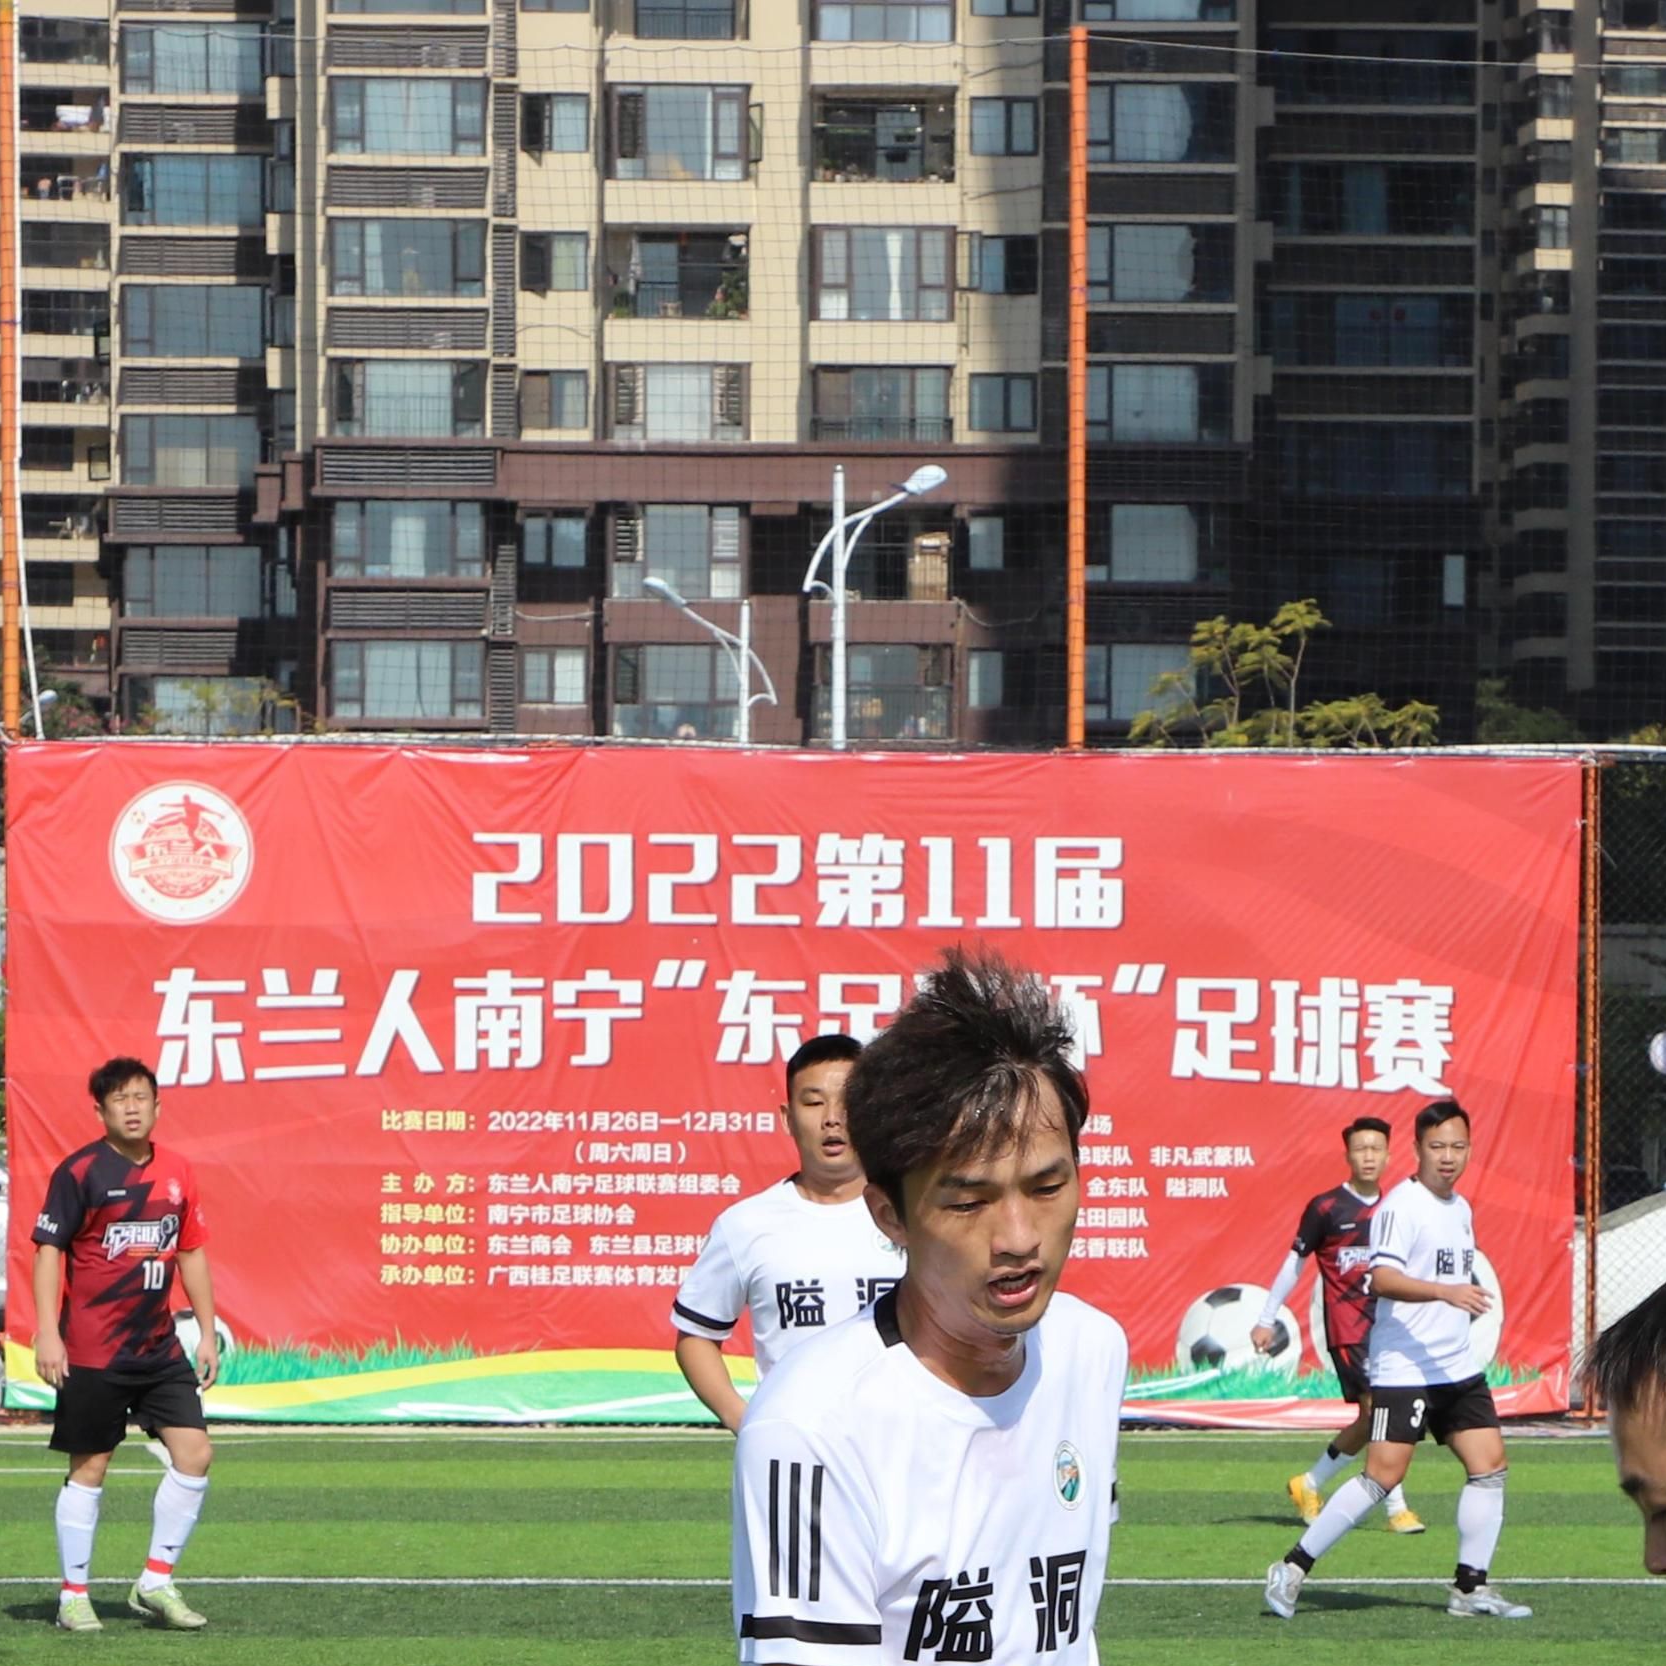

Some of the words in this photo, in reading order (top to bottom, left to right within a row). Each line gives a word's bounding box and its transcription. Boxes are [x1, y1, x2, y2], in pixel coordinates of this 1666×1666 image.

[472, 832, 1123, 928] 2022第11届
[380, 1110, 476, 1132] 比赛日期：
[574, 1141, 687, 1165] （周六周日）
[488, 1173, 741, 1194] 东兰人南宁足球联赛组委会
[1086, 1177, 1149, 1198] 金东队
[1165, 1177, 1229, 1198] 隘洞队
[380, 1203, 476, 1225] 指导单位：
[488, 1204, 636, 1225] 南宁市足球协会
[380, 1234, 476, 1256] 协办单位：
[488, 1235, 572, 1256] 东兰商会
[142, 1260, 165, 1291] 10
[380, 1264, 476, 1287] 承办单位：
[1410, 1398, 1426, 1429] 3
[903, 1549, 1088, 1663] 隘洞
